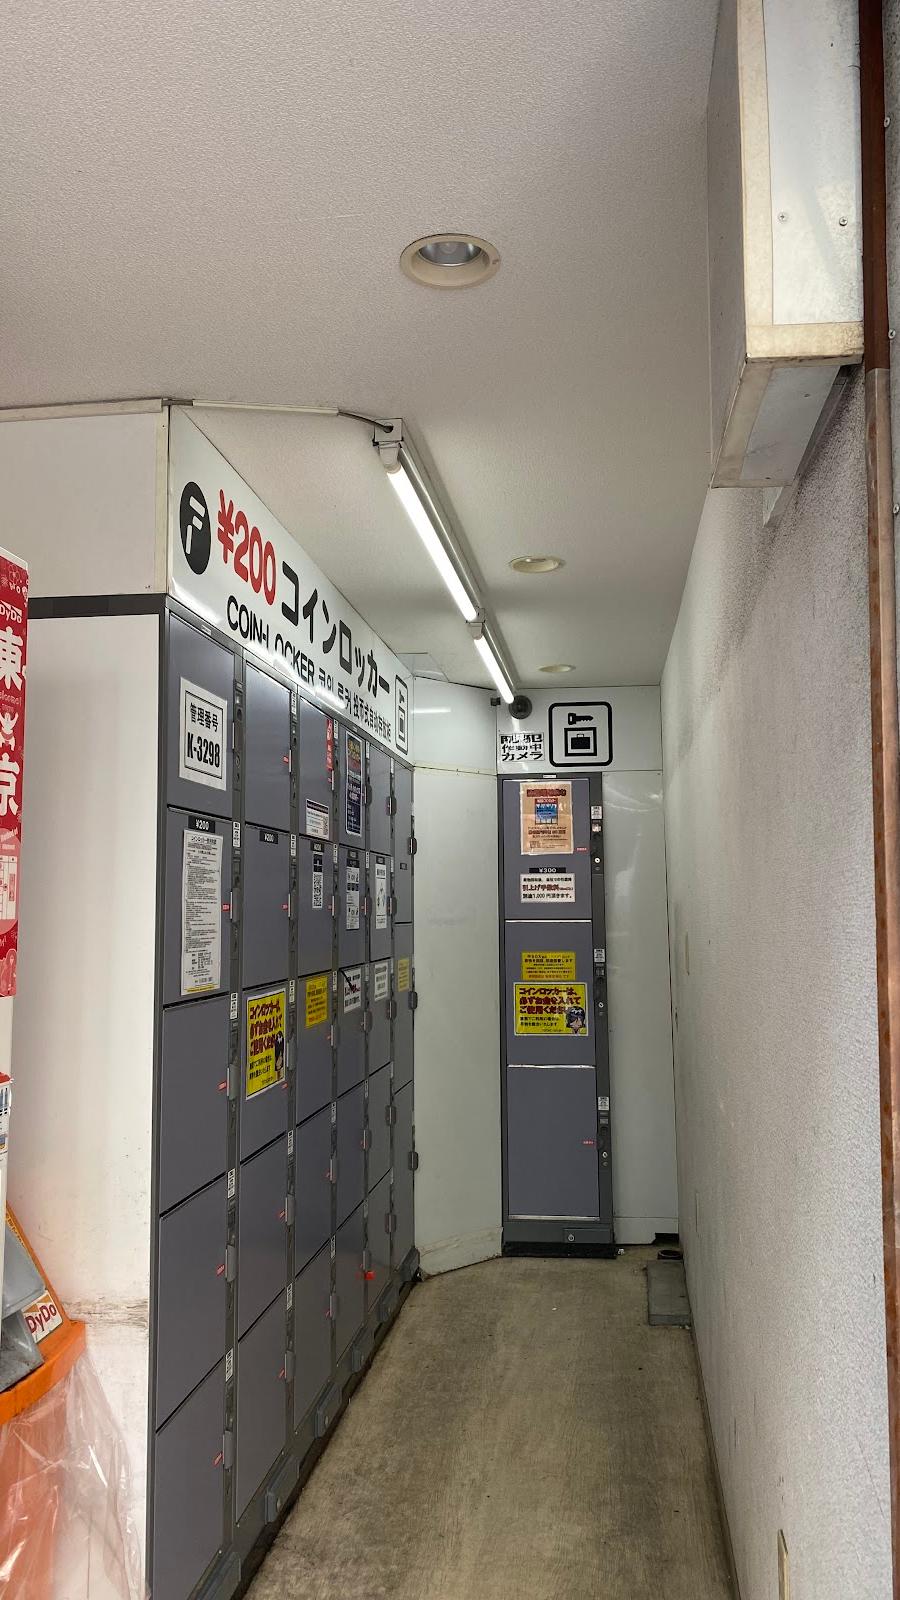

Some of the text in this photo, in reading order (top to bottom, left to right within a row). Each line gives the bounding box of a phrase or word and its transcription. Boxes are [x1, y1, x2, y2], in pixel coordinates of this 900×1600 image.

[0, 603, 22, 624] DyDo
[281, 560, 390, 698] コインロッカー
[187, 731, 221, 768] K-3298
[501, 752, 543, 761] カメラ
[24, 1304, 58, 1334] DyDo
